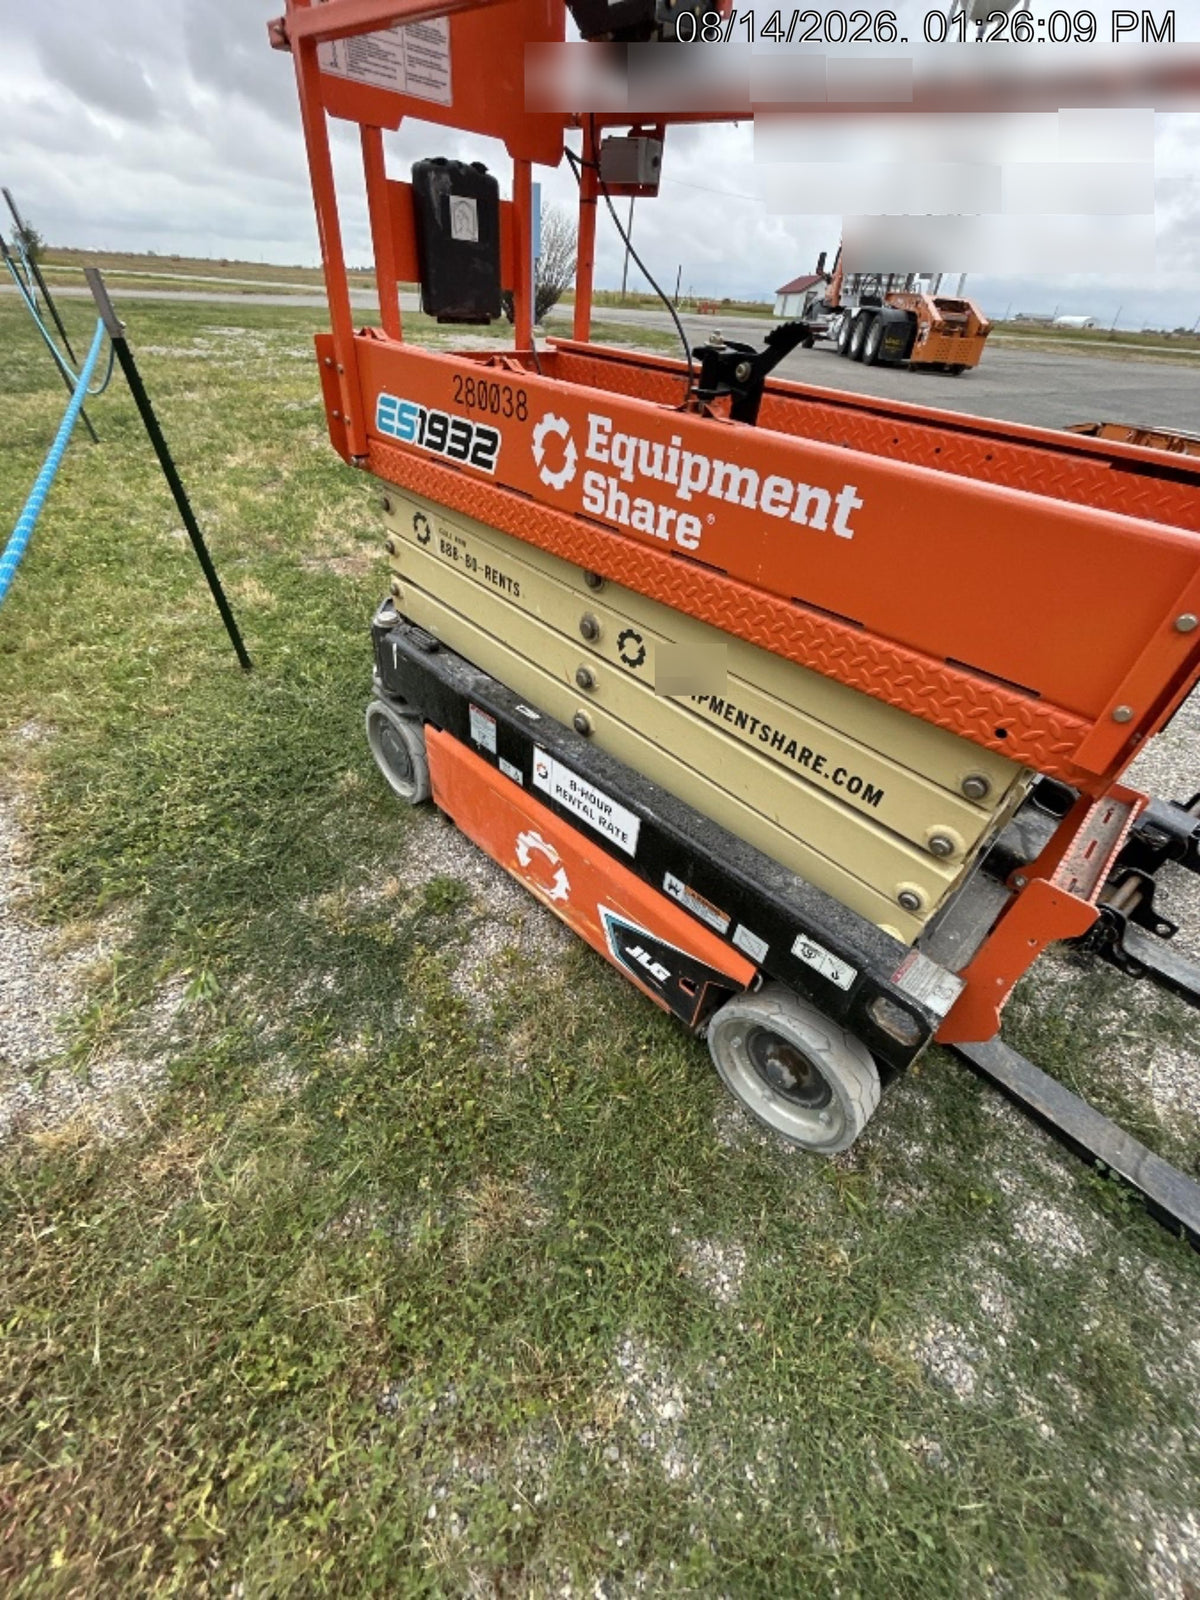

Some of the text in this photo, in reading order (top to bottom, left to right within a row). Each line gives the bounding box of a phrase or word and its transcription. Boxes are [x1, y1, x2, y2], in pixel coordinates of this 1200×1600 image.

[453, 374, 528, 422] 280038
[377, 395, 499, 471] ES1932
[585, 412, 864, 539] Equipment
[555, 784, 629, 843] RENTAL RATE
[569, 780, 613, 816] 8-HOUR
[625, 945, 671, 982] JLG
